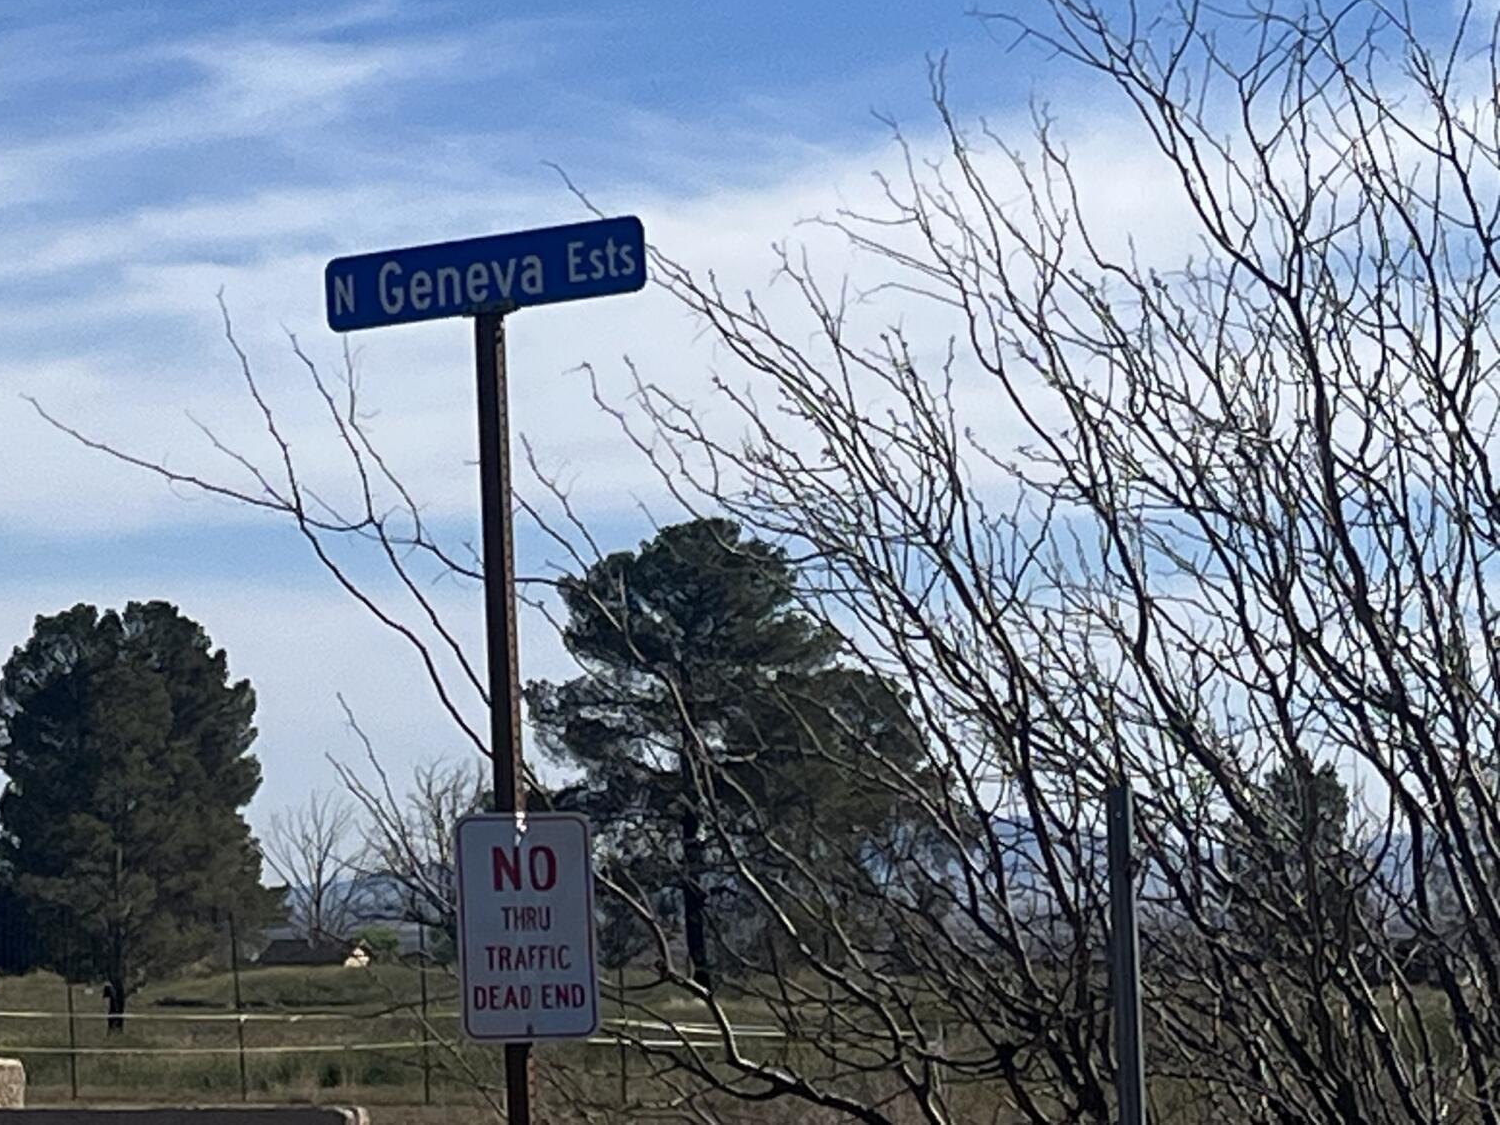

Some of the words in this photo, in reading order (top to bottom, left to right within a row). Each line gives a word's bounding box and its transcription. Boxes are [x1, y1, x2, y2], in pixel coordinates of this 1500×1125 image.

[334, 274, 355, 316] N
[378, 254, 544, 315] Geneva
[567, 236, 636, 283] Ests
[491, 844, 557, 892] NO
[501, 906, 551, 931] THRU
[485, 944, 571, 971] TRAFFIC
[473, 984, 531, 1011] DEAD
[541, 983, 586, 1009] END
